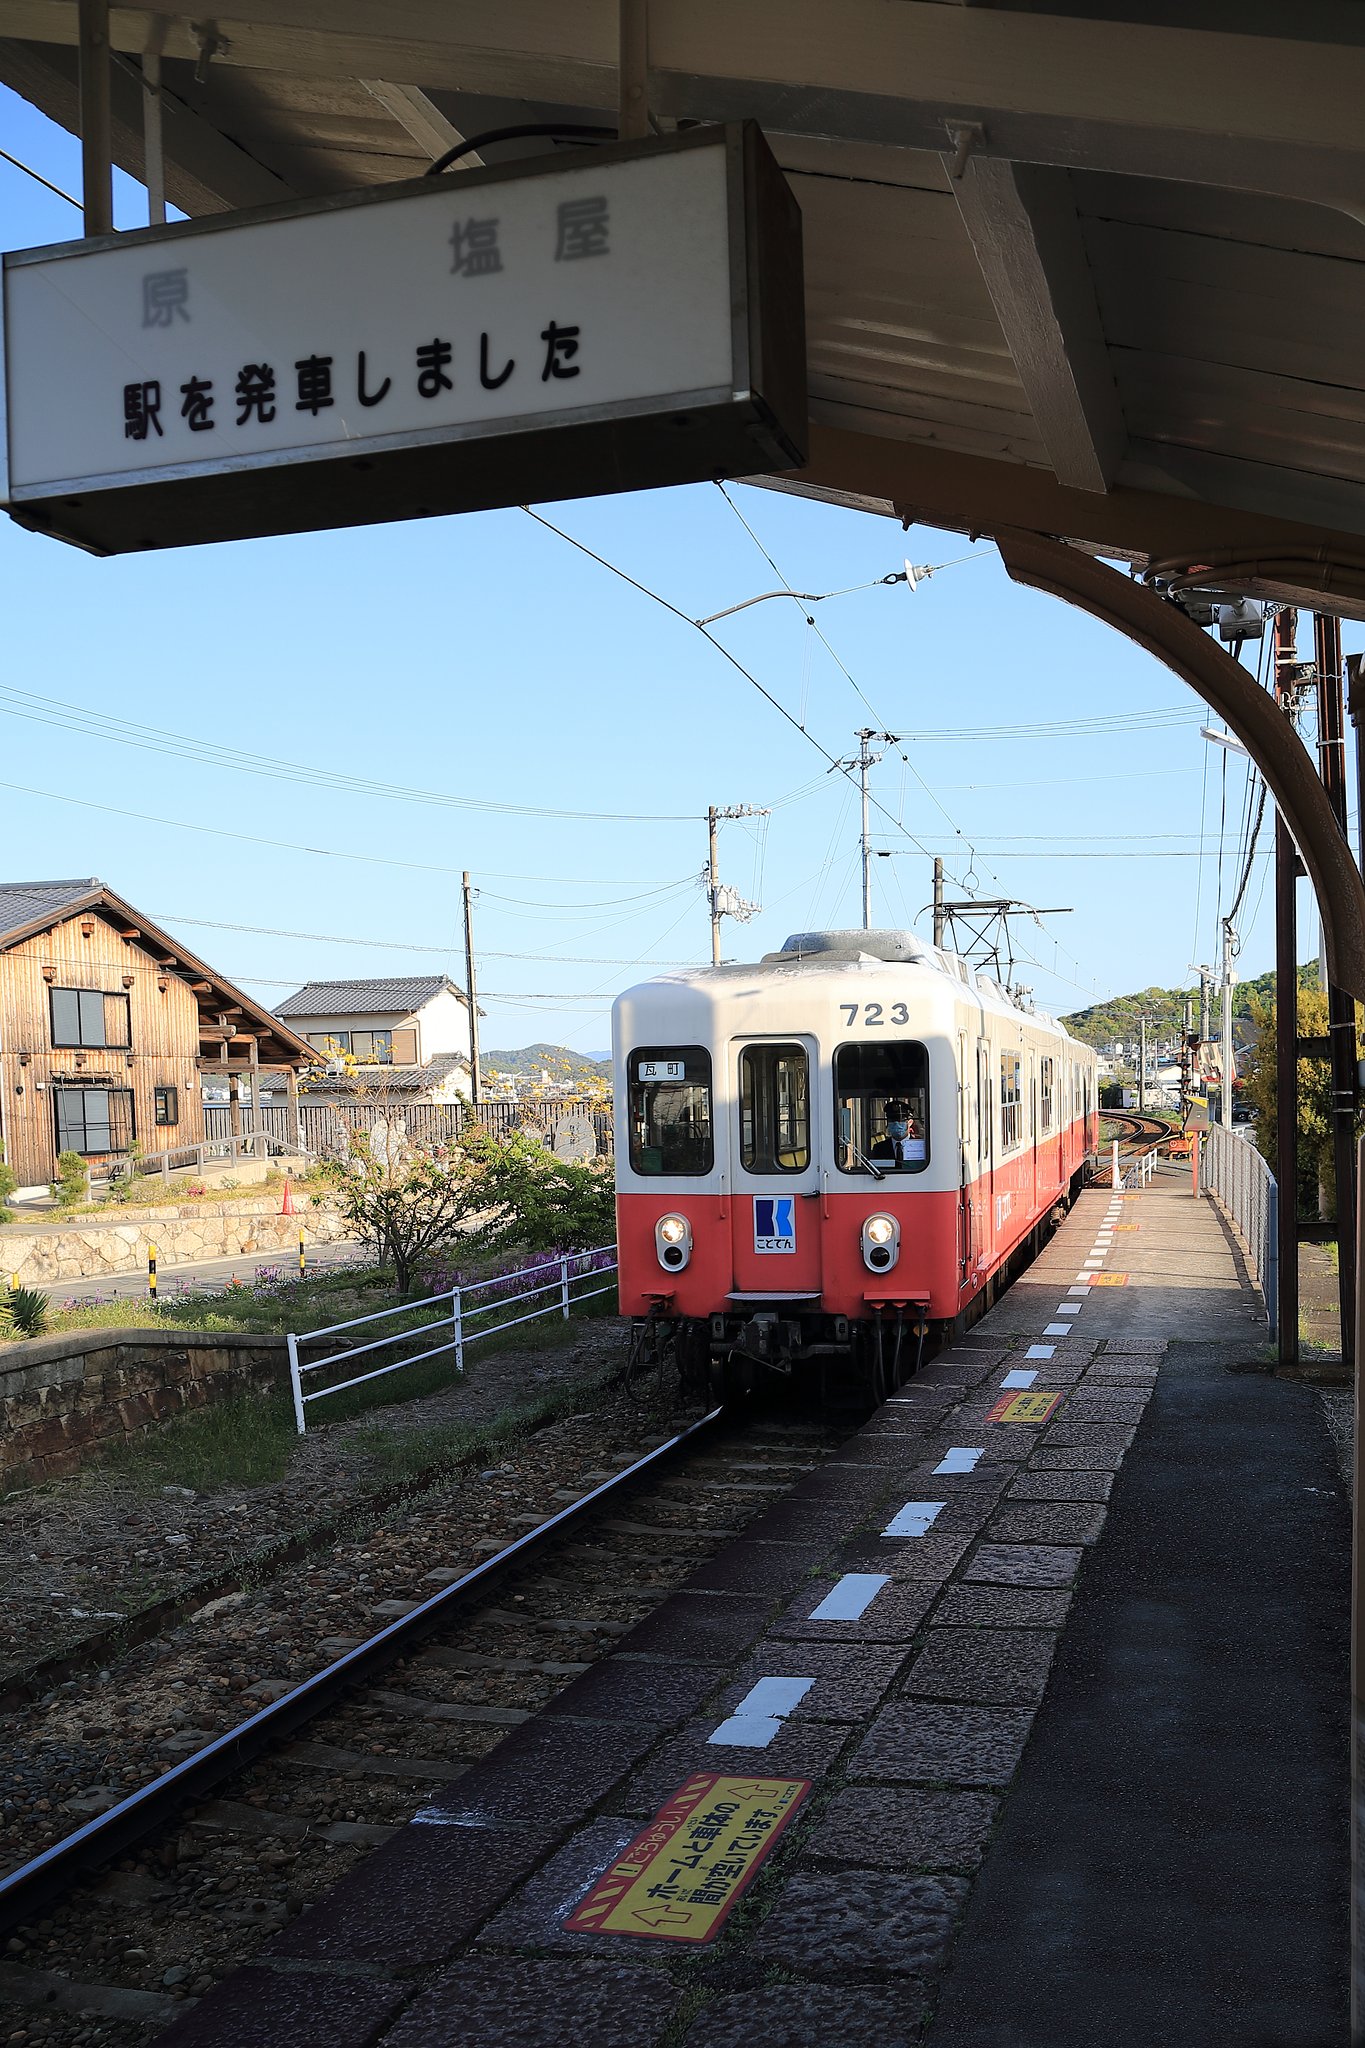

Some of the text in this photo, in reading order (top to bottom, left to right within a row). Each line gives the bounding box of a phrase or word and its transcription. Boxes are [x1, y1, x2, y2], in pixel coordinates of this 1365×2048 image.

[141, 268, 191, 329] 原
[123, 320, 580, 440] 駅を発車しました
[839, 1002, 910, 1026] 723
[644, 1062, 680, 1077] 瓦町
[756, 1238, 794, 1250] ことでん
[646, 1802, 741, 1901] ホームと車体の
[687, 1805, 784, 1906] 間が空いています。
